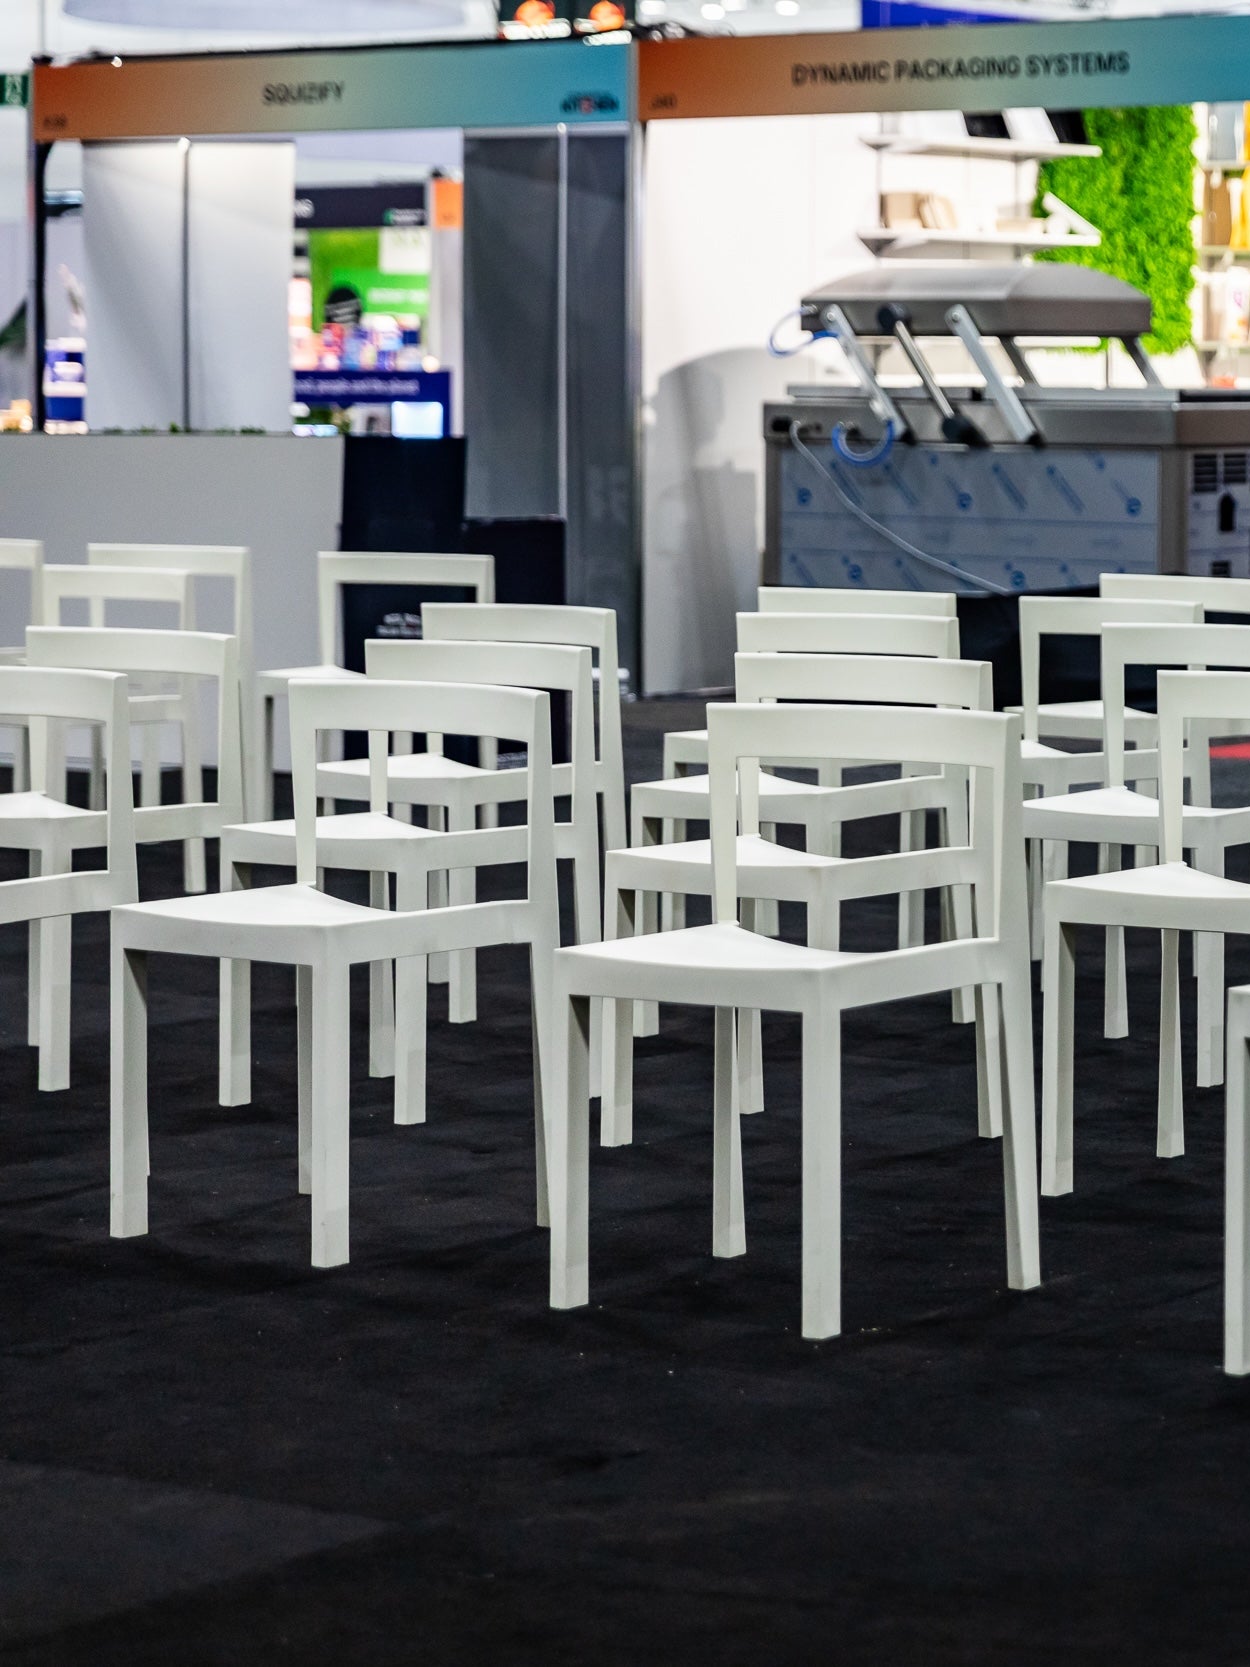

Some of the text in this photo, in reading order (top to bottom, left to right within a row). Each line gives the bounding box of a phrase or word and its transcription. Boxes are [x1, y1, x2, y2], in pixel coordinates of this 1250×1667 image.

[790, 50, 1131, 87] DYNAMIC PACKAGING SYSTEMS
[262, 81, 345, 106] SQUIZIFY
